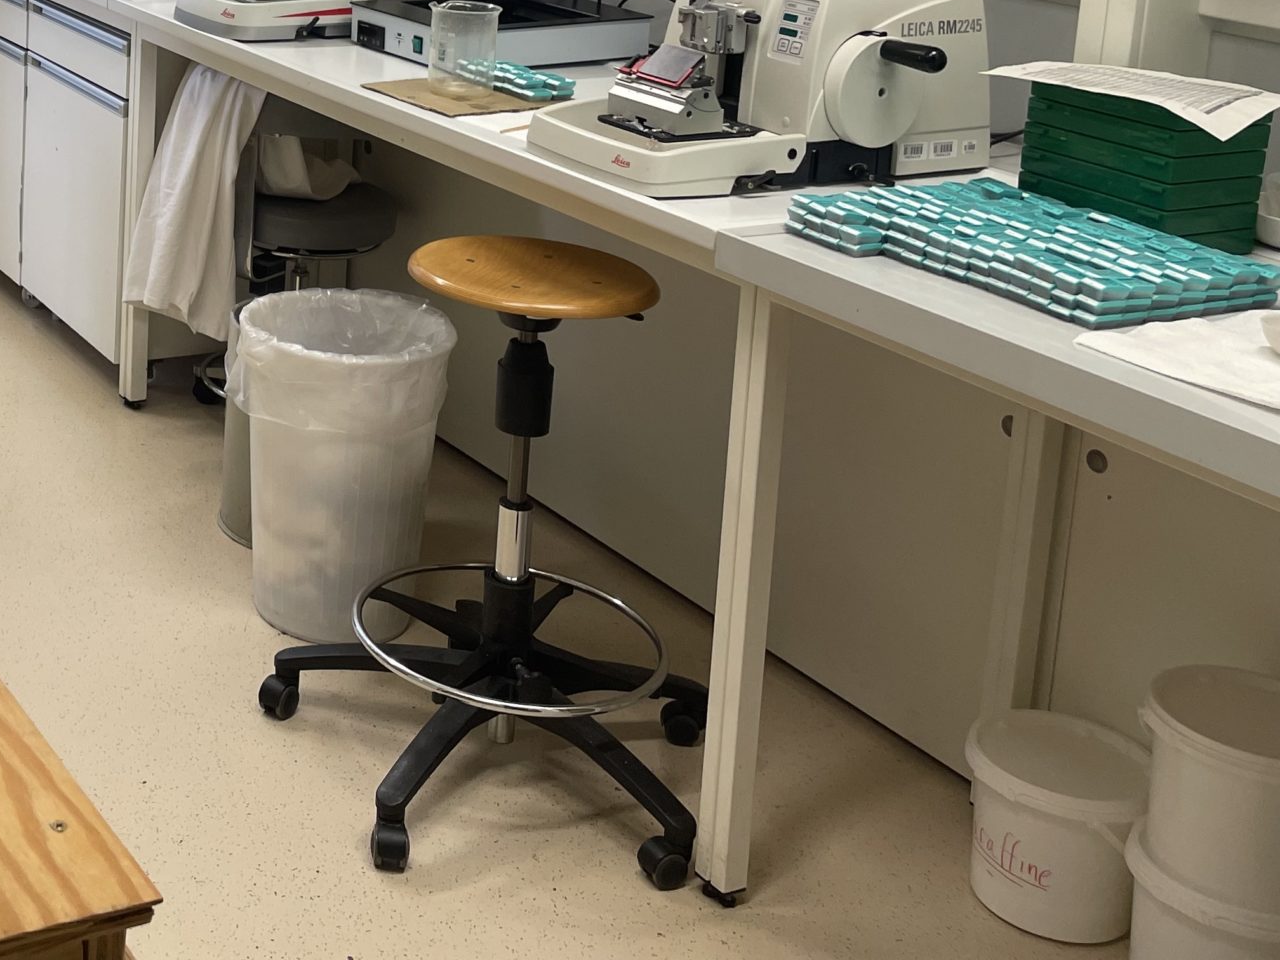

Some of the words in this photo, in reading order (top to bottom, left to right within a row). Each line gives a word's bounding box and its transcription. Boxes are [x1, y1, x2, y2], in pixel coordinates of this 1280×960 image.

[220, 7, 235, 20] Leica
[901, 21, 934, 38] LEICA
[938, 18, 982, 36] RM2245
[610, 153, 631, 169] Leica
